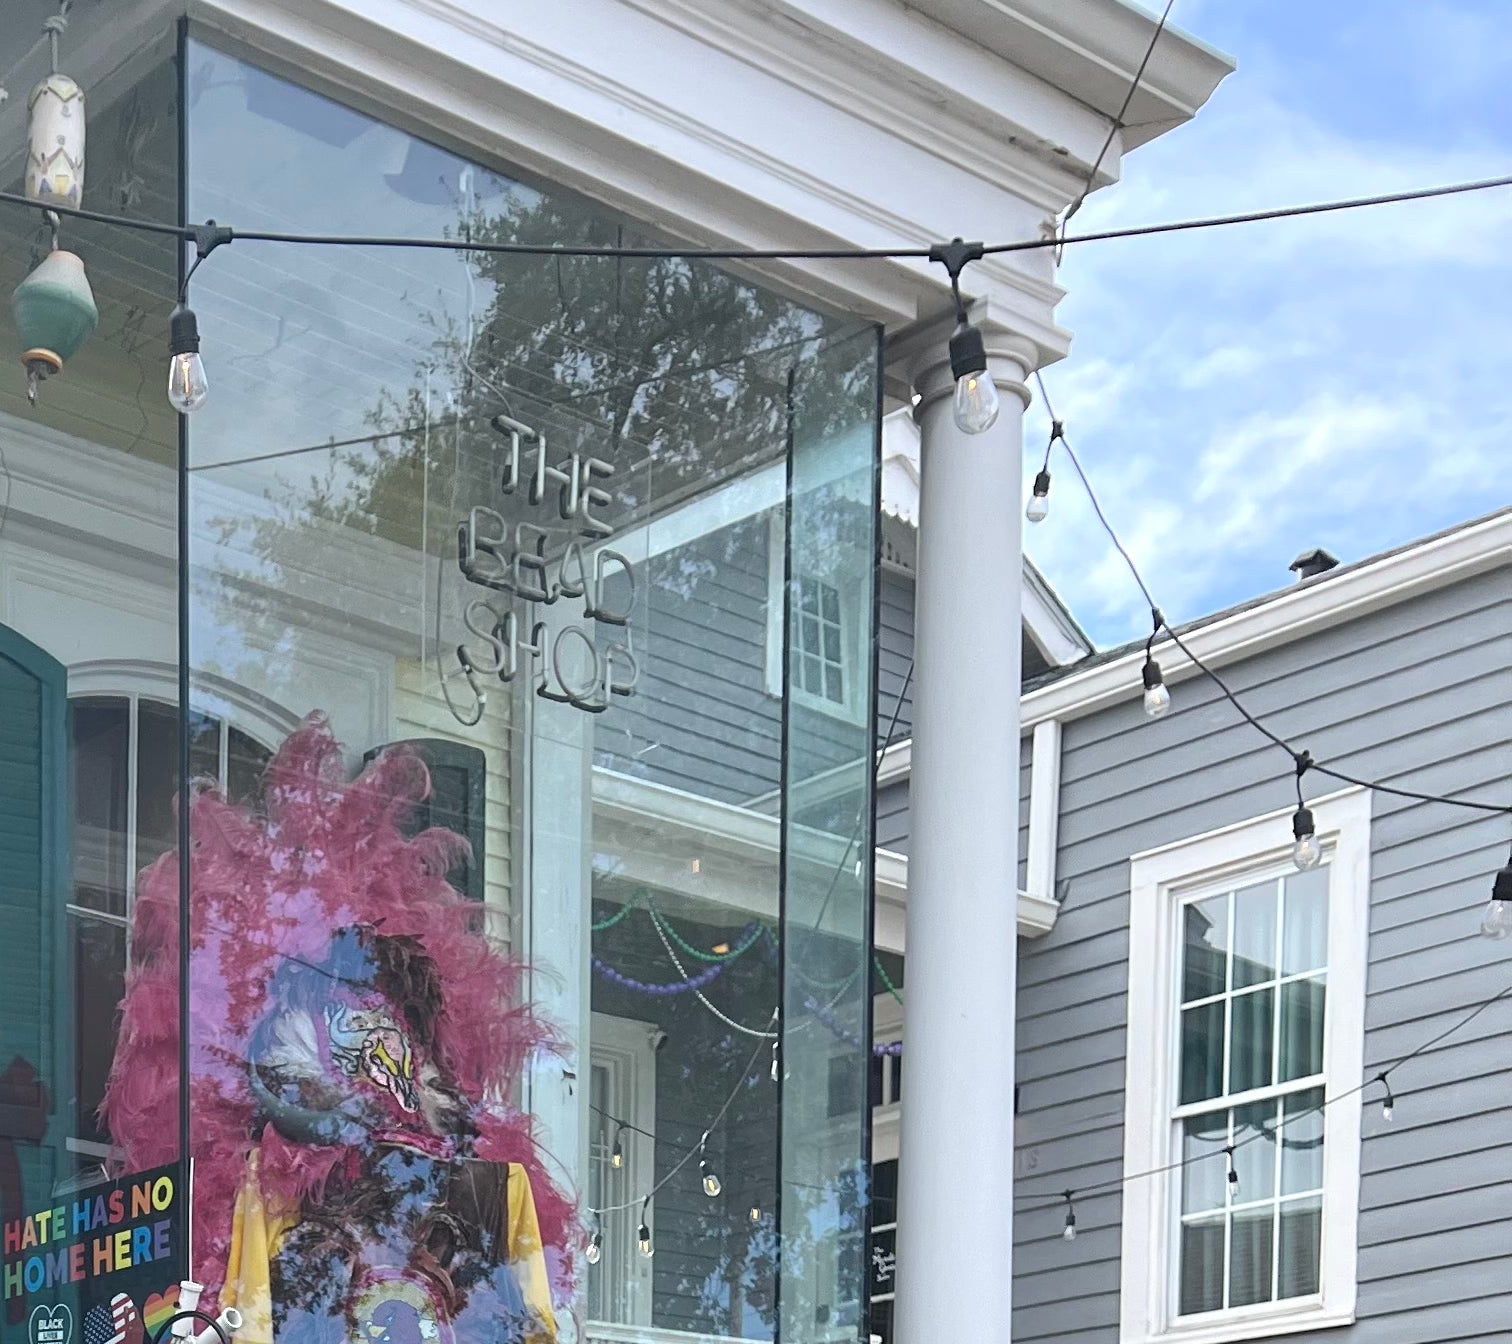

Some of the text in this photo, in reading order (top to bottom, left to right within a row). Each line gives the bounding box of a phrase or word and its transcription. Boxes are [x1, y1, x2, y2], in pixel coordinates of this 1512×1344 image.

[491, 414, 615, 538] THE
[457, 506, 637, 626] BEAD
[457, 600, 639, 713] SHOP
[4, 1176, 174, 1255] HATE HAS NO
[4, 1217, 172, 1300] HOME HERE
[38, 1318, 64, 1330] BLACK
